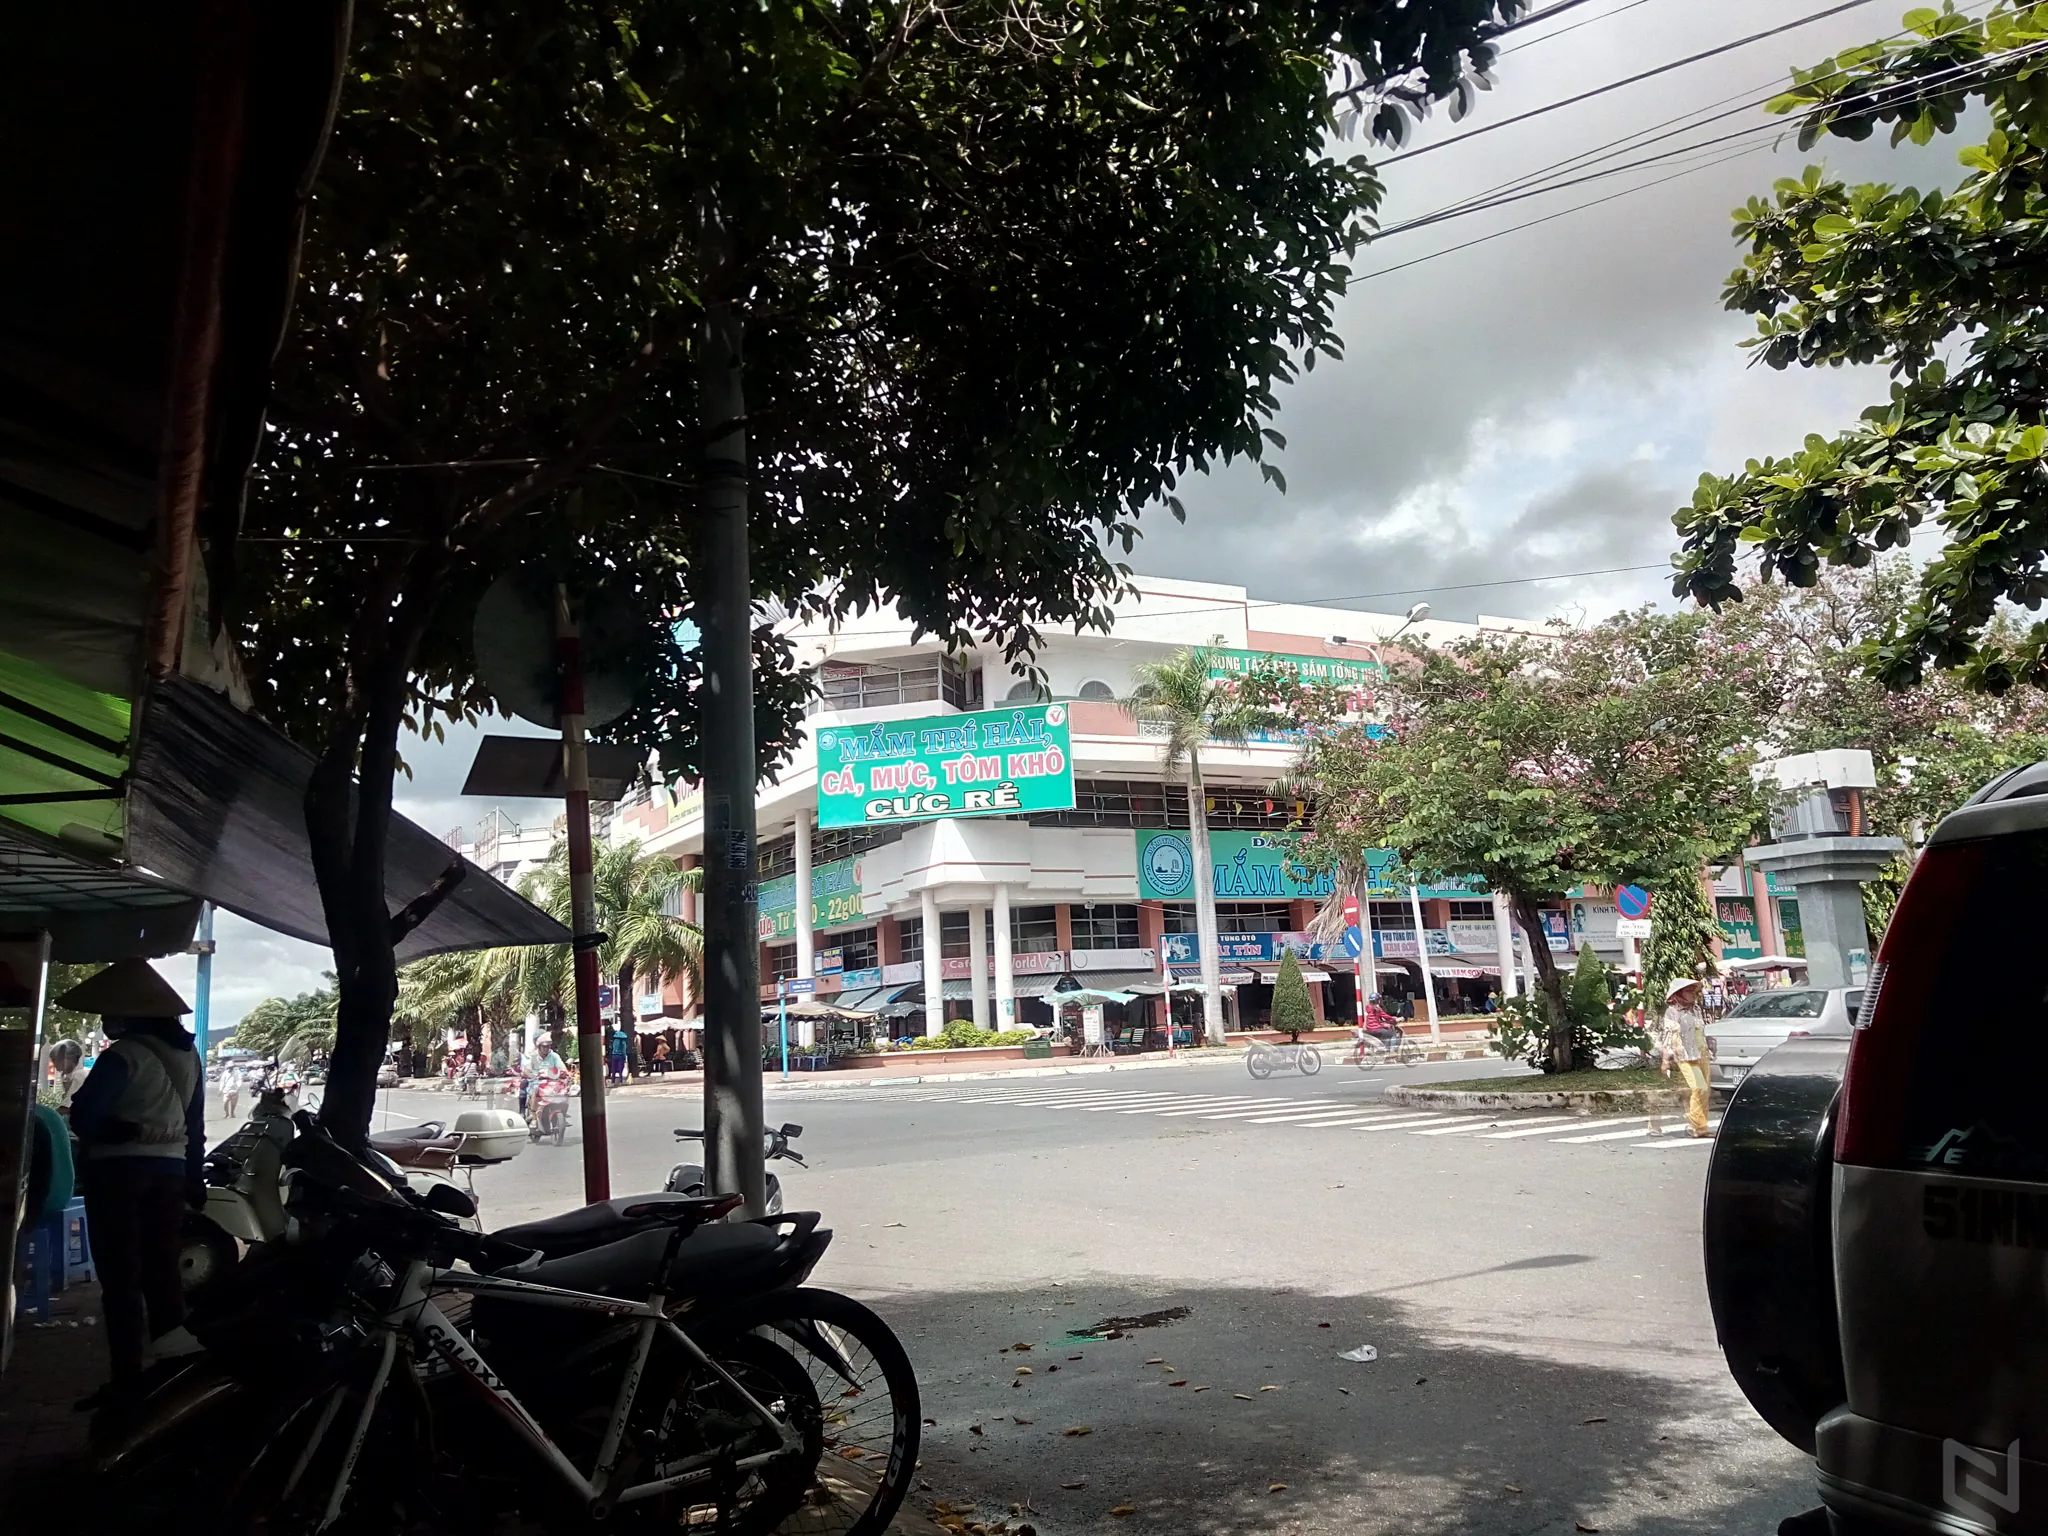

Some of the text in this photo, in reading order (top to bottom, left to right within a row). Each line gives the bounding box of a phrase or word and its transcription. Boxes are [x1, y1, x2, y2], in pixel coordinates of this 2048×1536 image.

[1211, 654, 1241, 671] RUNG
[1302, 659, 1327, 677] SẮM
[1330, 661, 1358, 681] TỔNG
[840, 710, 1052, 763] MẮM TRÍ HẢI,
[822, 745, 1066, 797] CÁ, MỰC, TÔM KHÔ
[865, 781, 1020, 818] CỰC RẺ
[1292, 864, 1337, 896] TR
[1592, 905, 1610, 914] KÍNH
[1012, 956, 1038, 972] orld
[1233, 942, 1262, 956] TÍN
[424, 1324, 506, 1392] GALAXY
